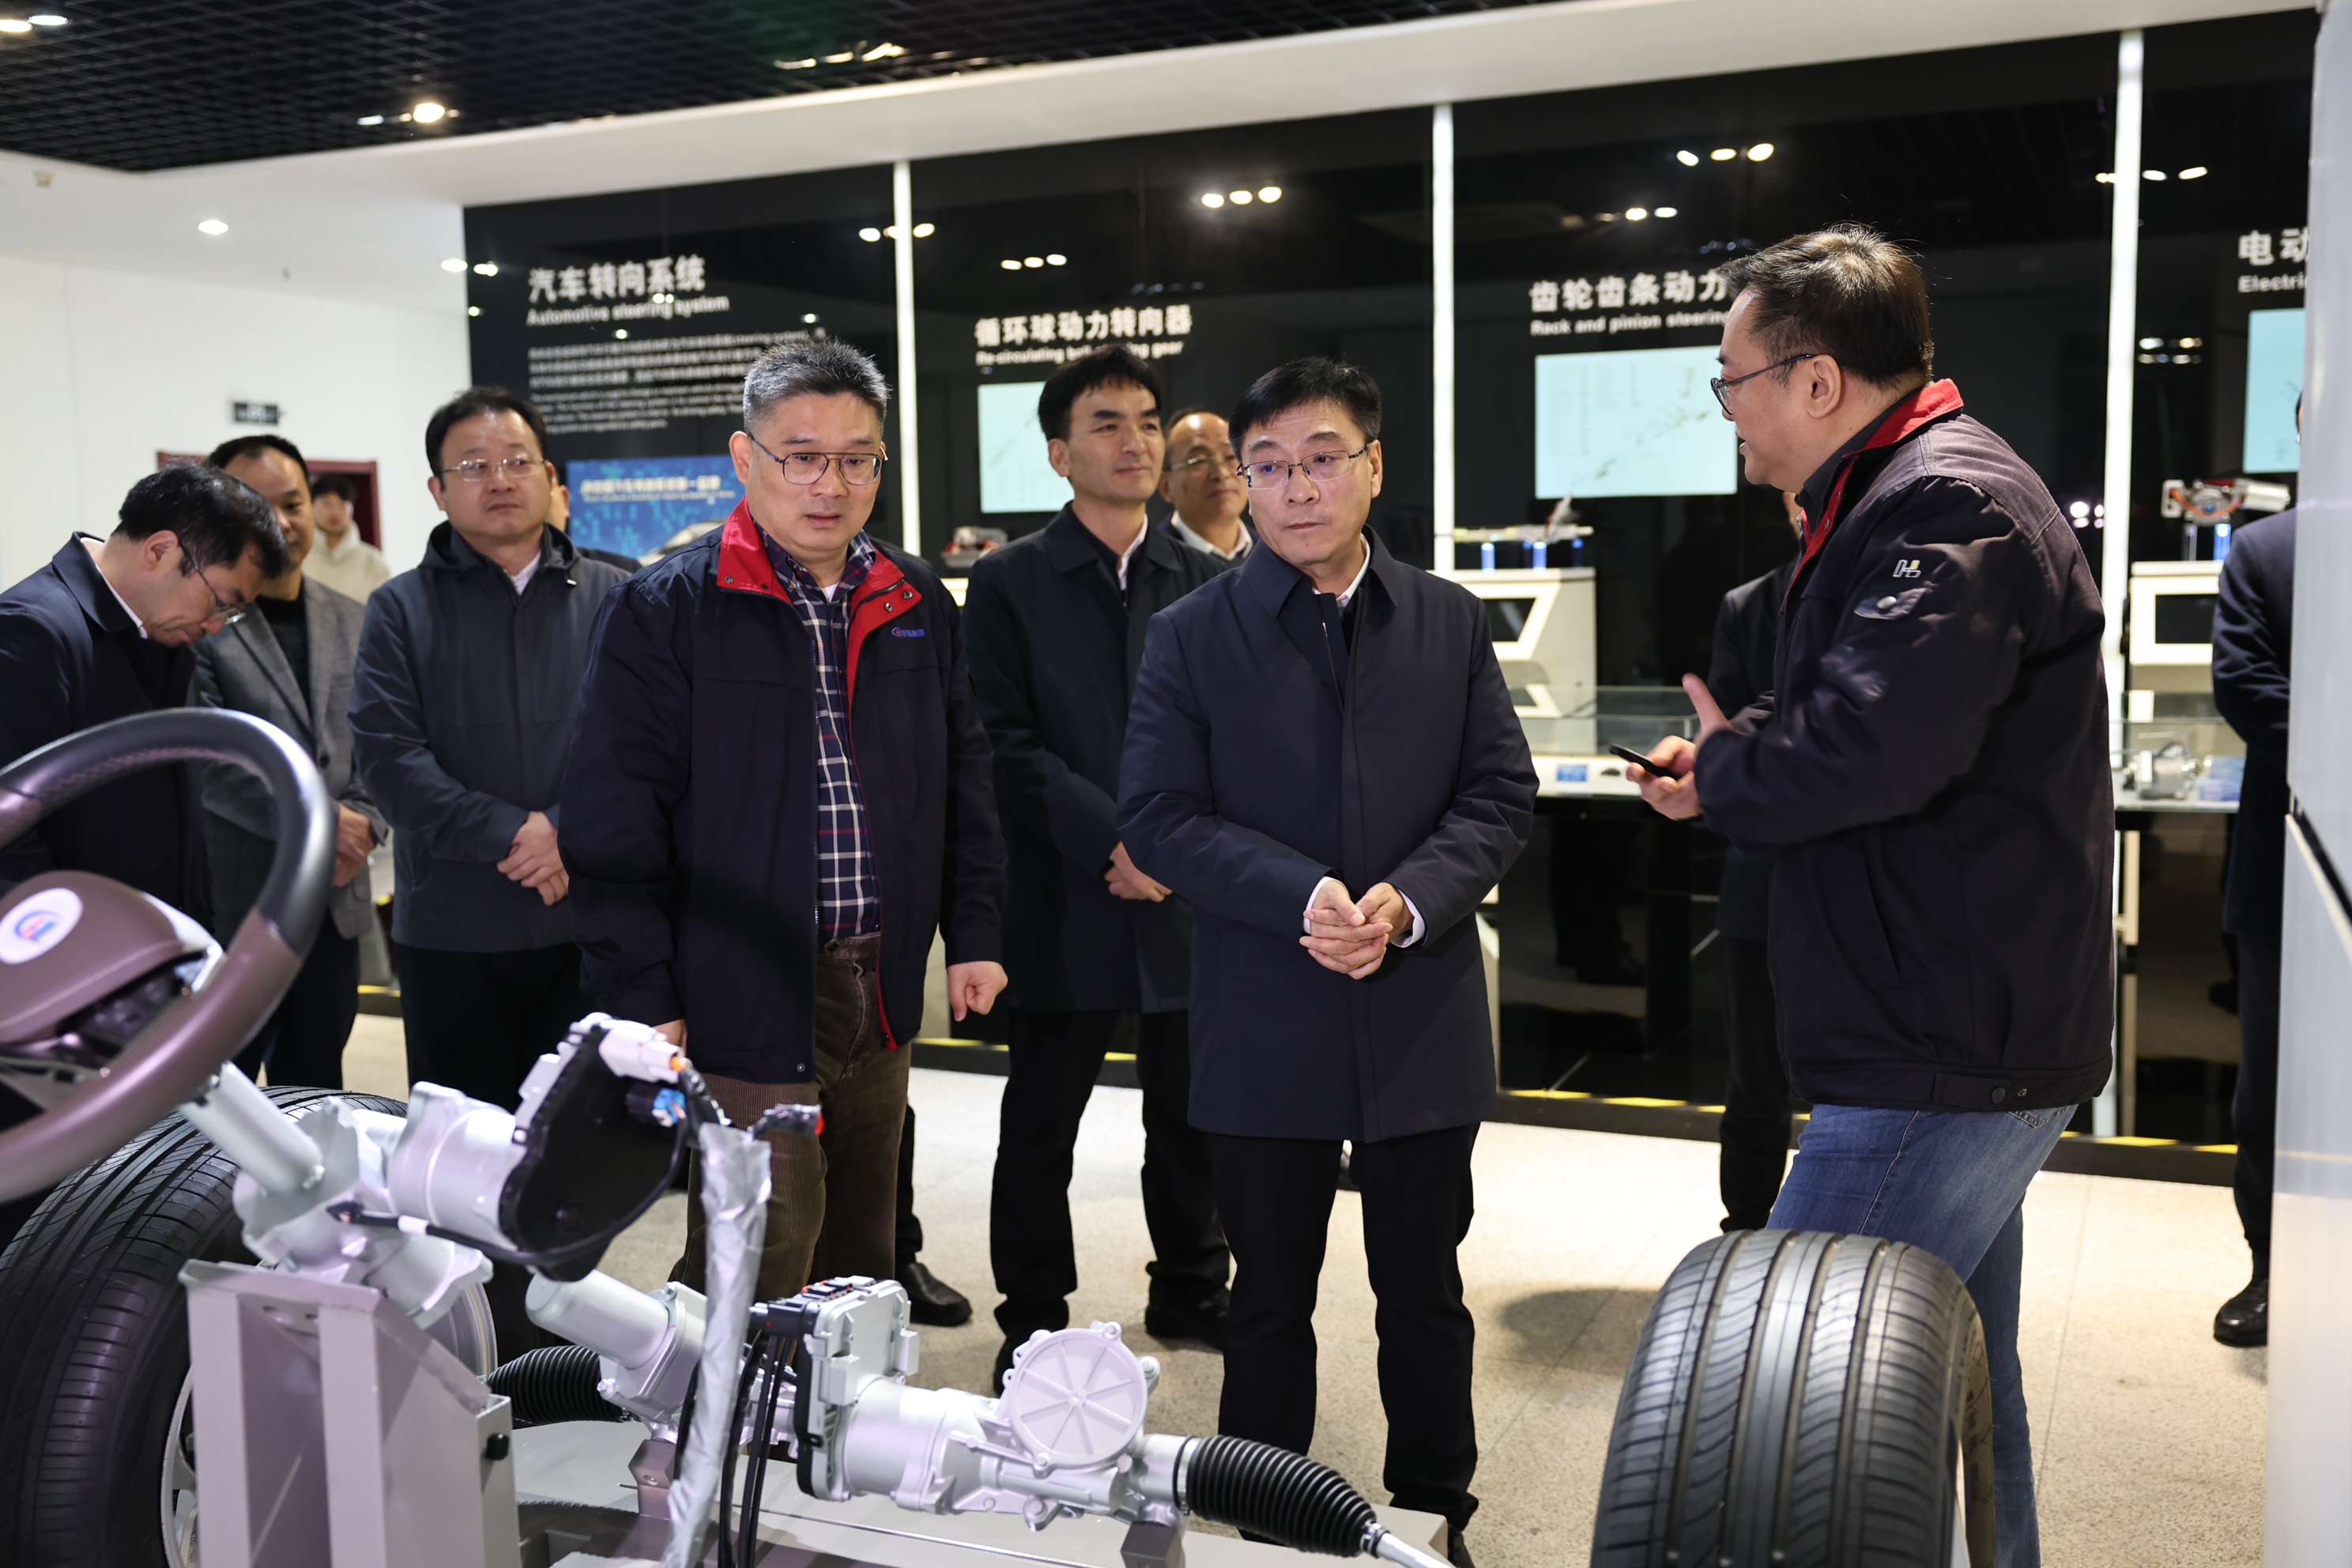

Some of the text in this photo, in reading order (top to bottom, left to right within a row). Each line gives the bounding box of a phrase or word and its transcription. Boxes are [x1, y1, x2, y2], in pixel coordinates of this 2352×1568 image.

[2238, 228, 2309, 266] 电动
[528, 254, 705, 303] 汽车转向系统
[1529, 270, 1727, 312] 齿轮齿条动力
[2238, 272, 2308, 292] Electri
[526, 296, 730, 326] Automotive steering system
[975, 303, 1192, 348] 循环球动力转向器
[1530, 318, 1572, 336] Rack
[1574, 316, 1607, 333] and
[1608, 313, 1662, 335] pinion
[1152, 341, 1184, 359] gear
